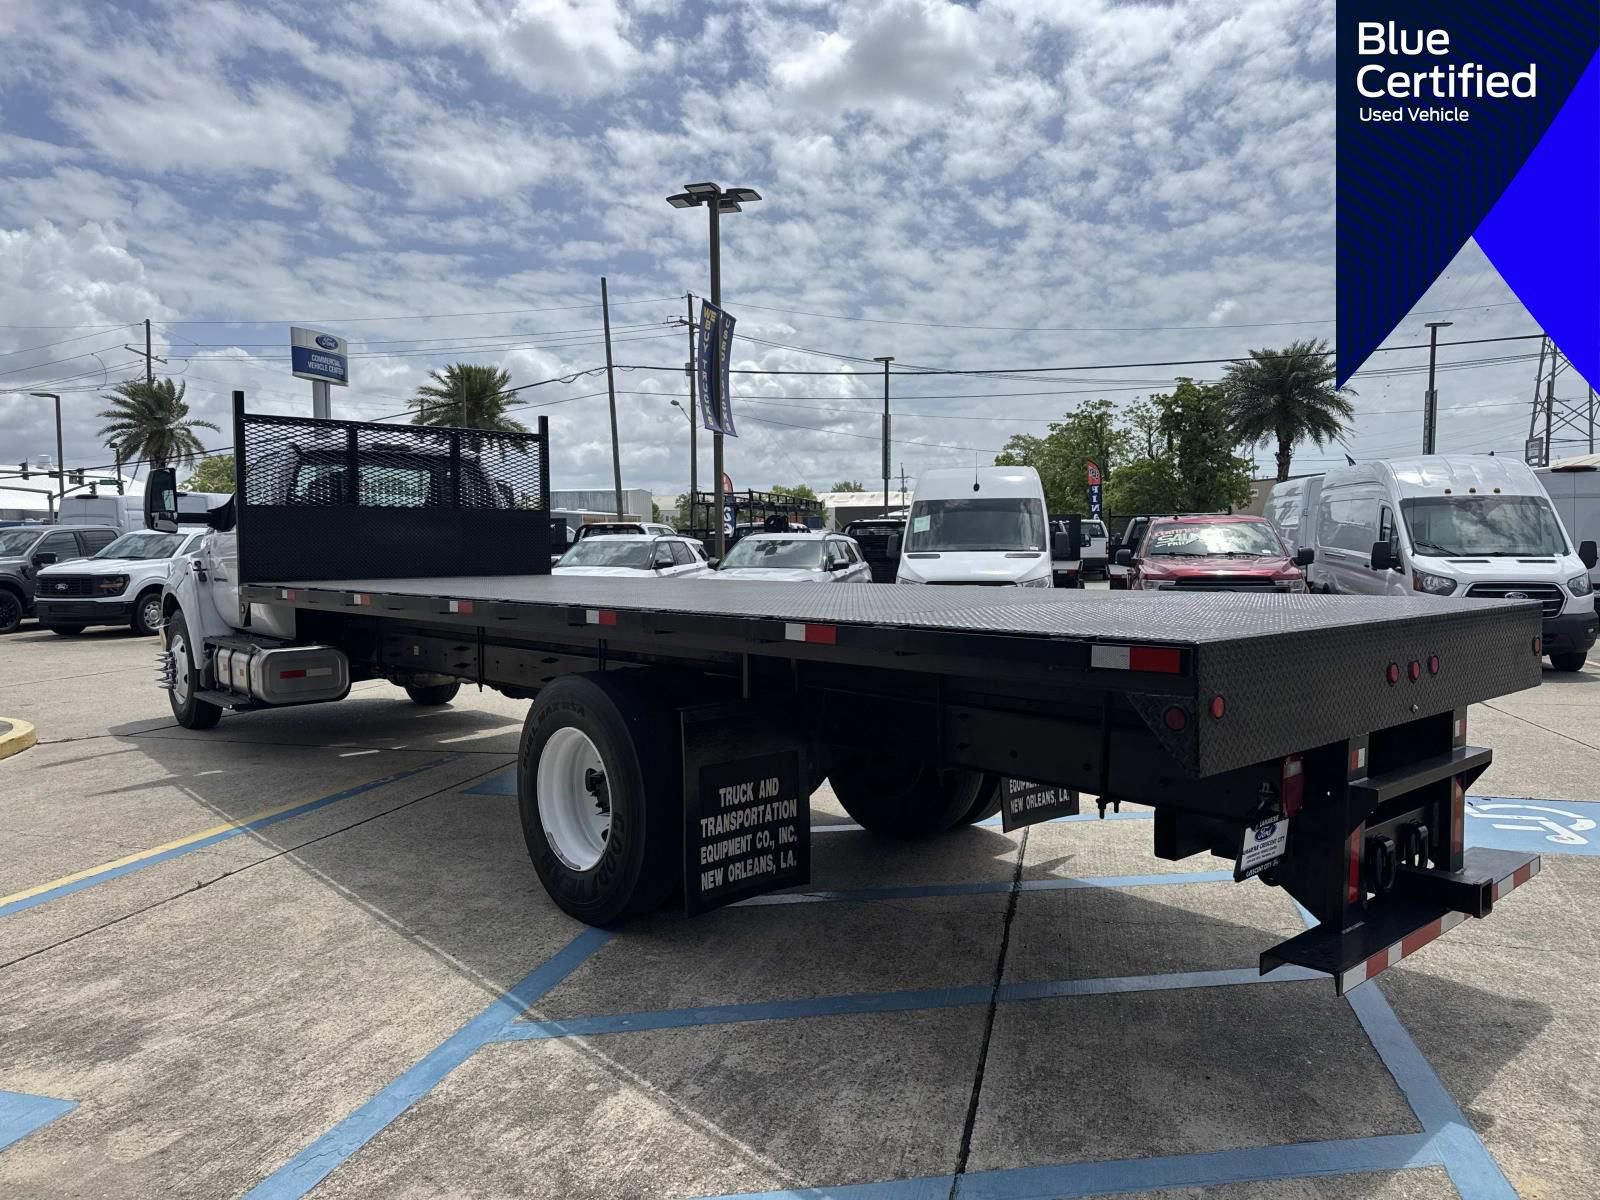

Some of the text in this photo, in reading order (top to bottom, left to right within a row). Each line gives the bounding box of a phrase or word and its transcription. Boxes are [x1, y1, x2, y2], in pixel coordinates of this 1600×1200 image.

[307, 360, 329, 372] VEHICLE
[702, 306, 717, 426] WE BUY TRUCKS
[719, 777, 779, 808] TRUCK AND
[1010, 788, 1070, 814] NEW ORLEANS, LA.
[700, 799, 797, 838] TRANSPORTATION
[700, 834, 752, 865] EQUIPMENT
[779, 825, 798, 844] INC.
[701, 849, 797, 891] NEW ORLEANS, LA.
